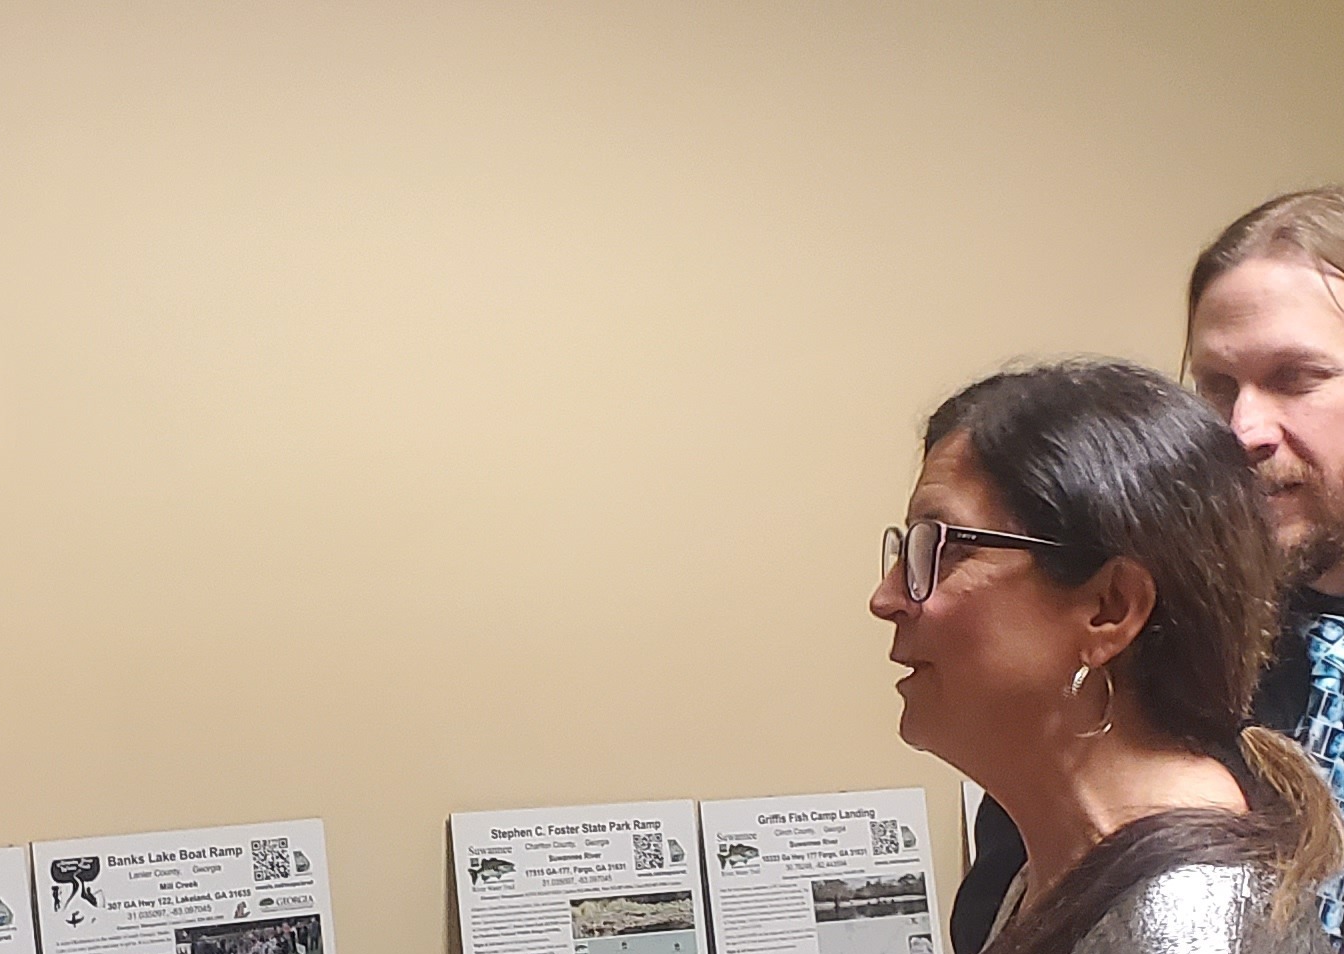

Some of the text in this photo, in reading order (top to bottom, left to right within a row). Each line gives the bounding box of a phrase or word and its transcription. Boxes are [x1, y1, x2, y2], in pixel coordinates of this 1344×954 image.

[758, 808, 876, 825] Griffis Fish Camp Landing
[490, 819, 662, 841] Stephen C. Foster State Park Ramp
[468, 845, 513, 856] Suwannee
[107, 855, 145, 867] Banks
[148, 851, 176, 863] Lake
[179, 849, 206, 860] Boat
[209, 847, 243, 858] Ramp
[548, 851, 602, 862] Suwannee River
[192, 864, 222, 874] Georgia
[595, 864, 607, 872] GA
[159, 880, 198, 890] Mill Creek
[107, 902, 122, 911] 307
[123, 900, 137, 909] GA
[138, 899, 156, 908] Hwy
[158, 897, 174, 906] 122,
[175, 893, 212, 904] Lakeland,
[215, 891, 227, 900] GA
